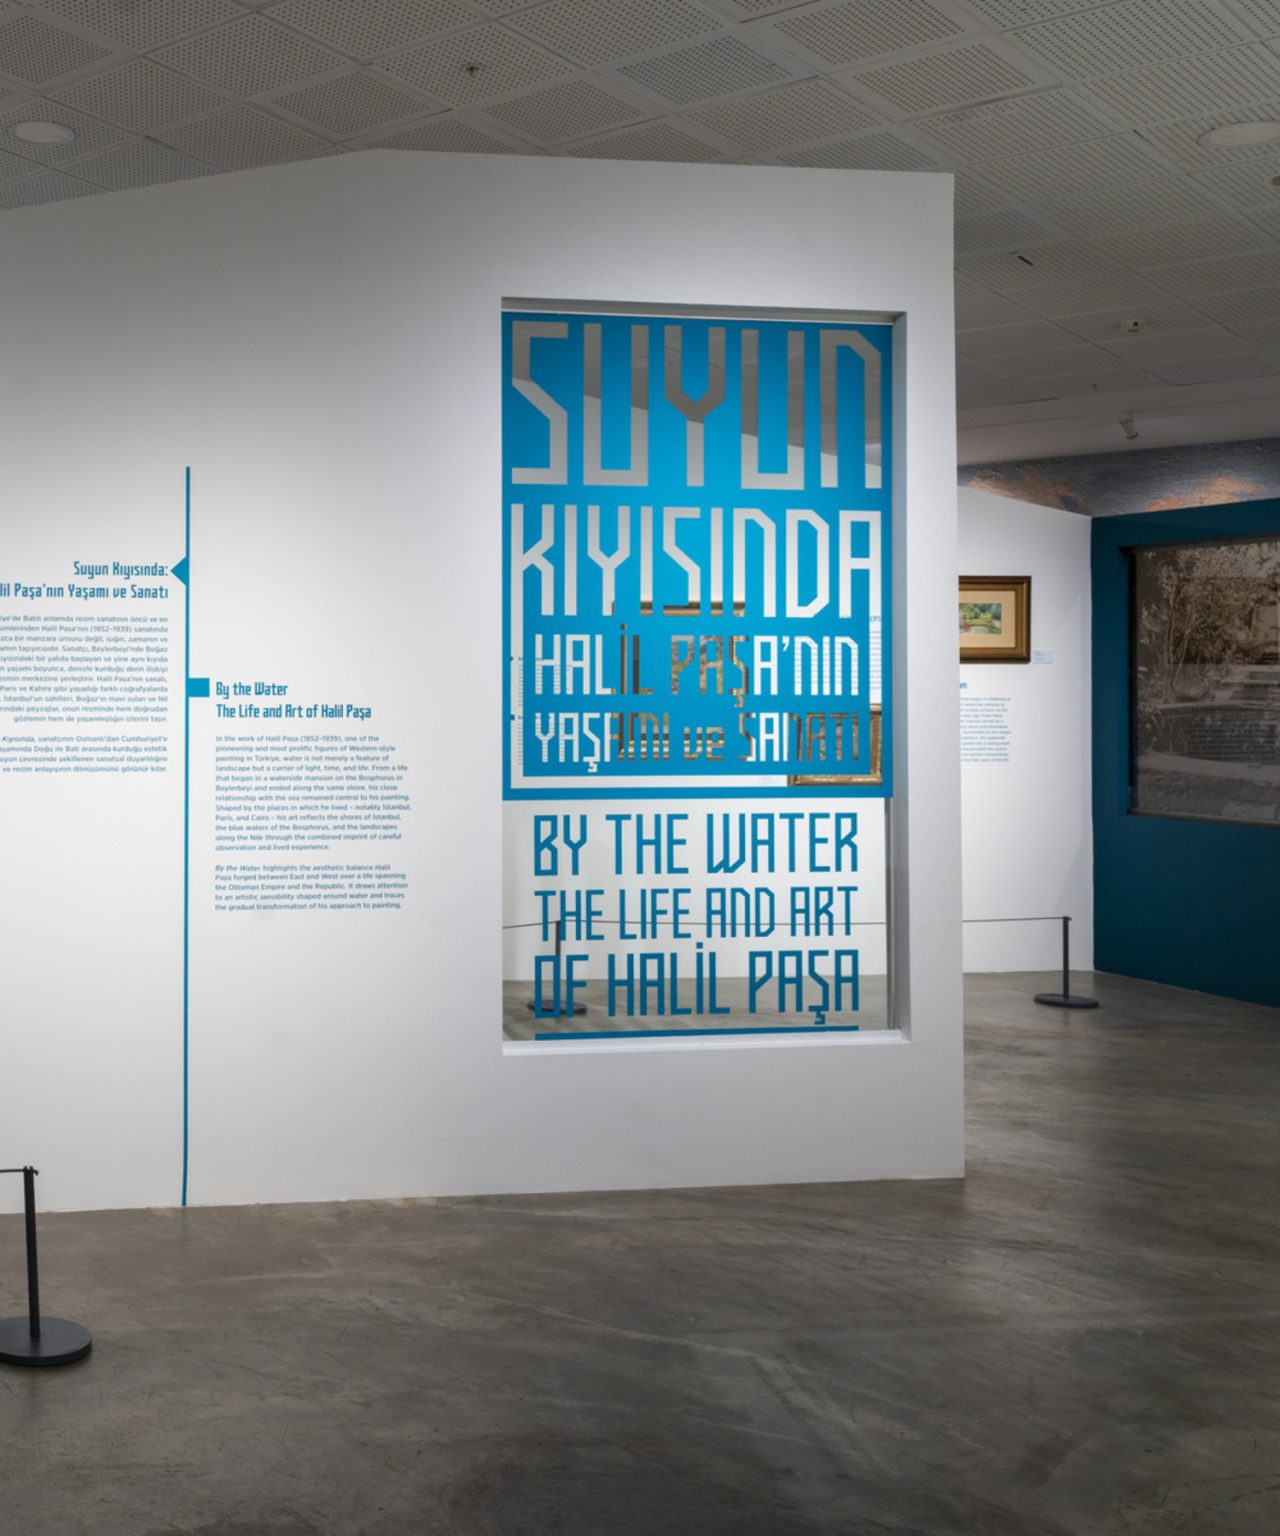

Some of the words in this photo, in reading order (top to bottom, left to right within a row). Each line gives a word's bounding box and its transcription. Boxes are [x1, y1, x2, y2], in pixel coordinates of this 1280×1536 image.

[512, 320, 881, 490] SUYUN
[511, 504, 881, 618] KIYISINDA
[74, 561, 109, 579] Suyun
[112, 562, 168, 579] Kıyısında:
[14, 583, 64, 600] Paşa'nın
[68, 584, 109, 600] Yaşamı
[113, 587, 126, 598] ve
[131, 584, 168, 599] Sanatı
[535, 624, 653, 695] HALİL
[671, 635, 859, 708] PAŞA'NIN
[216, 682, 230, 699] By
[233, 682, 251, 696] the
[255, 682, 288, 696] Water
[216, 704, 236, 718] The
[239, 704, 259, 718] Life
[263, 704, 282, 718] and
[285, 704, 302, 718] Art
[306, 704, 318, 718] of
[321, 704, 344, 719] Halil
[346, 704, 372, 721] Paşa
[224, 734, 236, 742] the
[238, 734, 255, 742] work
[265, 734, 281, 742] Halil
[282, 734, 299, 744] Paşa
[367, 734, 379, 742] the
[535, 712, 669, 772] YAŞAMI
[684, 727, 724, 761] ve
[739, 712, 859, 761] SANATI
[216, 744, 254, 754] pioneering
[255, 744, 268, 752] and
[270, 744, 287, 752] most
[289, 744, 312, 754] prolific
[314, 744, 338, 754] figures
[348, 744, 395, 753] Western-style
[216, 754, 245, 764] painting
[255, 754, 282, 764] Türkiye,
[283, 754, 302, 762] water
[311, 754, 323, 762] not
[325, 754, 348, 763] merely
[355, 754, 380, 762] feature
[216, 764, 251, 774] landscape
[252, 764, 264, 772] but
[272, 764, 294, 772] carrier
[304, 764, 321, 773] light,
[324, 764, 342, 772] time,
[343, 763, 357, 771] and
[357, 763, 370, 771] life.
[372, 763, 390, 771] From
[397, 763, 408, 771] life
[216, 774, 230, 782] that
[231, 774, 254, 784] began
[269, 774, 303, 782] waterside
[304, 774, 333, 782] mansion
[345, 773, 357, 781] the
[358, 773, 395, 783] Bosphorus
[216, 784, 253, 794] Beylerbeyi
[254, 784, 268, 792] and
[269, 784, 291, 792] ended
[292, 783, 312, 793] along
[313, 783, 324, 791] the
[346, 783, 367, 792] shore,
[368, 783, 378, 791] his
[380, 783, 397, 791] close
[534, 814, 587, 876] BY
[606, 814, 689, 875] THE
[707, 812, 858, 873] WATER
[226, 864, 238, 872] the
[239, 863, 261, 871] Water
[262, 863, 298, 873] highlights
[299, 863, 311, 871] the
[312, 863, 344, 871] aesthetic
[346, 863, 373, 871] balance
[375, 863, 391, 871] Halil
[215, 903, 226, 911] the
[228, 902, 255, 912] gradual
[256, 902, 307, 910] transformation
[317, 902, 328, 910] his
[329, 901, 362, 911] approach
[372, 901, 402, 911] painting.
[534, 890, 604, 941] THE
[620, 888, 691, 940] LIFE
[706, 887, 775, 938] AND
[791, 886, 858, 937] ART
[535, 954, 589, 1019] OF
[608, 942, 730, 1017] HALİL
[749, 949, 859, 1025] PAŞA
